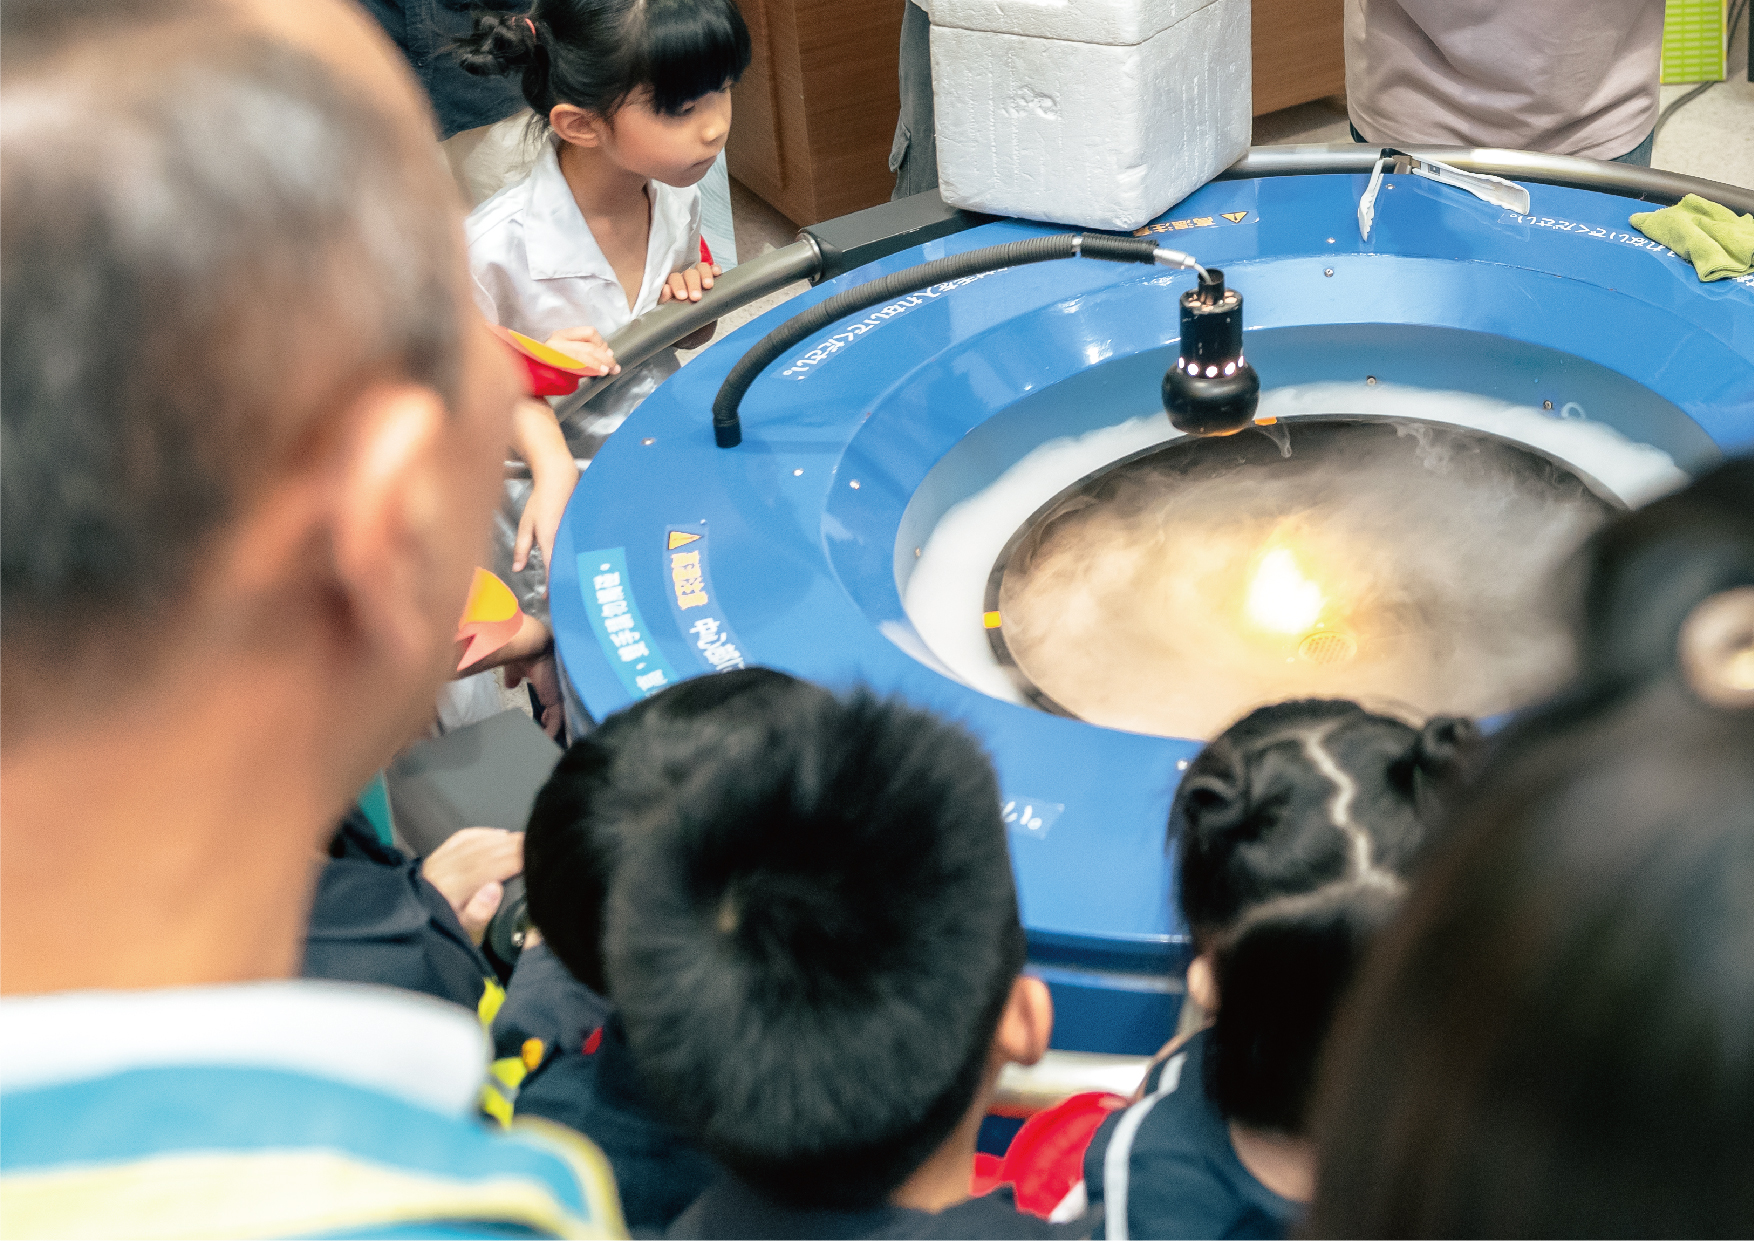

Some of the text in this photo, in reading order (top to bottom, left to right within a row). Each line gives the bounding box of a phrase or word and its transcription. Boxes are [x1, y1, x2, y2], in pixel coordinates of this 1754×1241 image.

[1510, 213, 1676, 258] れないでください。
